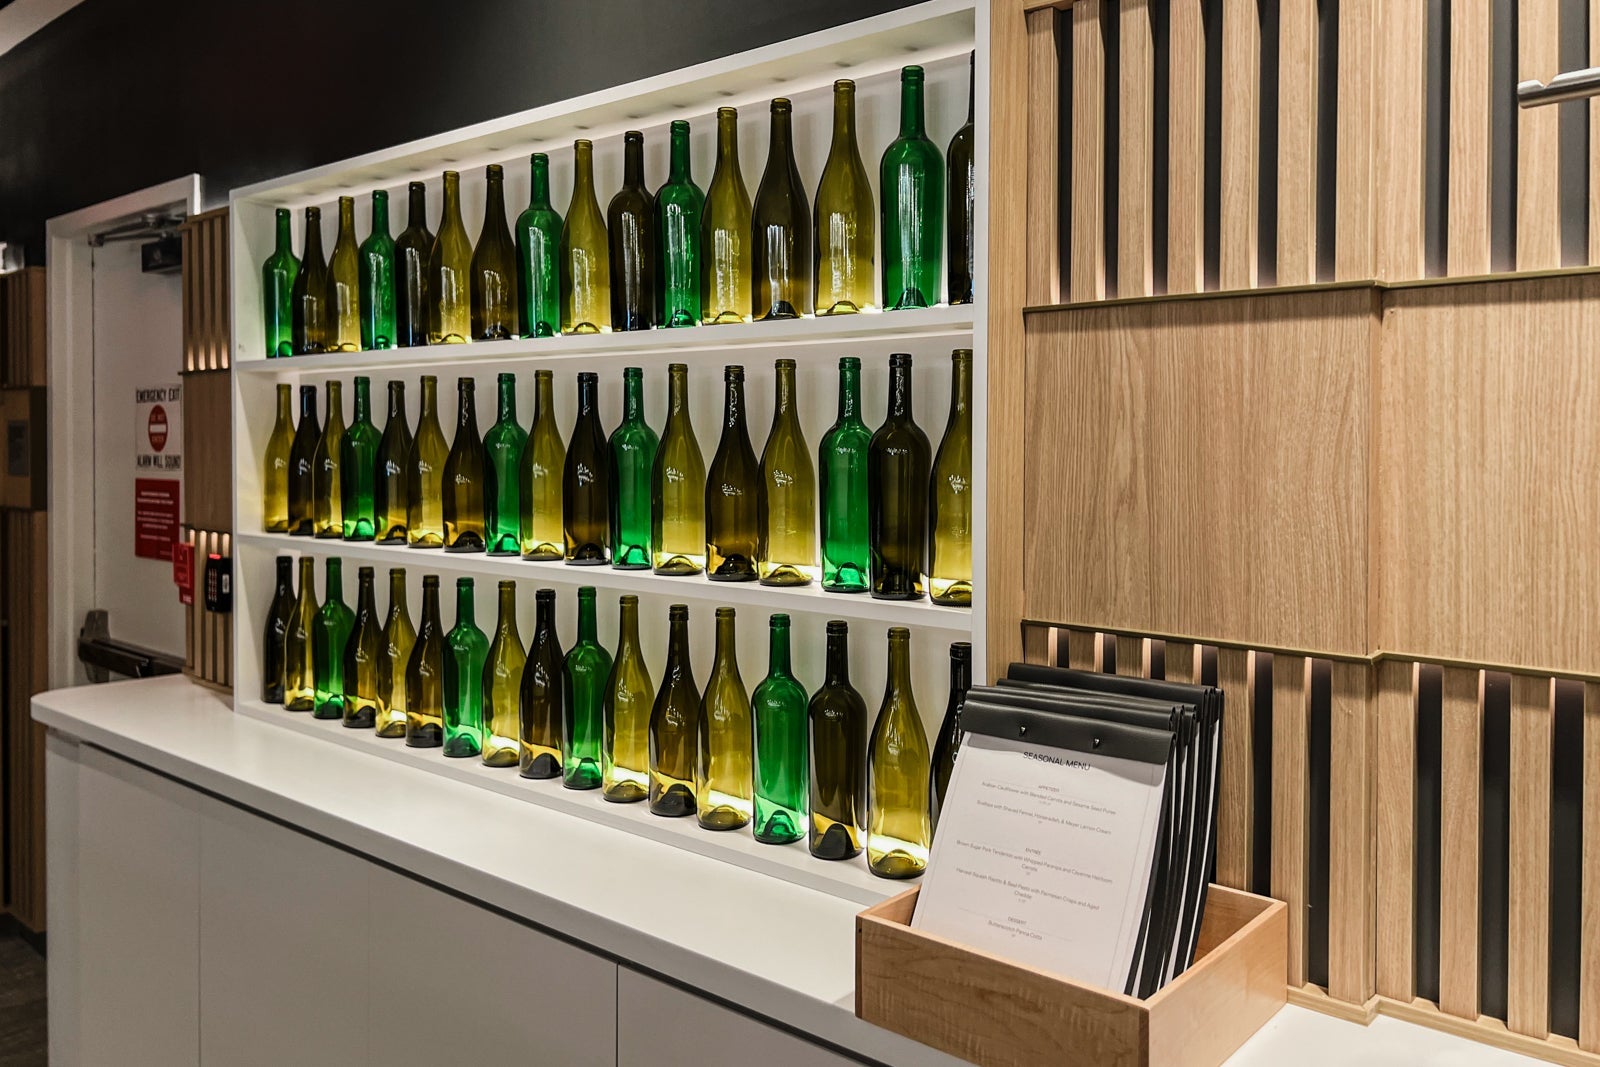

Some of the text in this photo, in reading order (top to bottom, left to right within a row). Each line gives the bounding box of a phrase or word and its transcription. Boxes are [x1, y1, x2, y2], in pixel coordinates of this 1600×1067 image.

[136, 388, 180, 403] EMERGENCY EXIT
[137, 455, 181, 470] ALARM WILL SOUND
[1024, 751, 1091, 771] SEASONAL MENU
